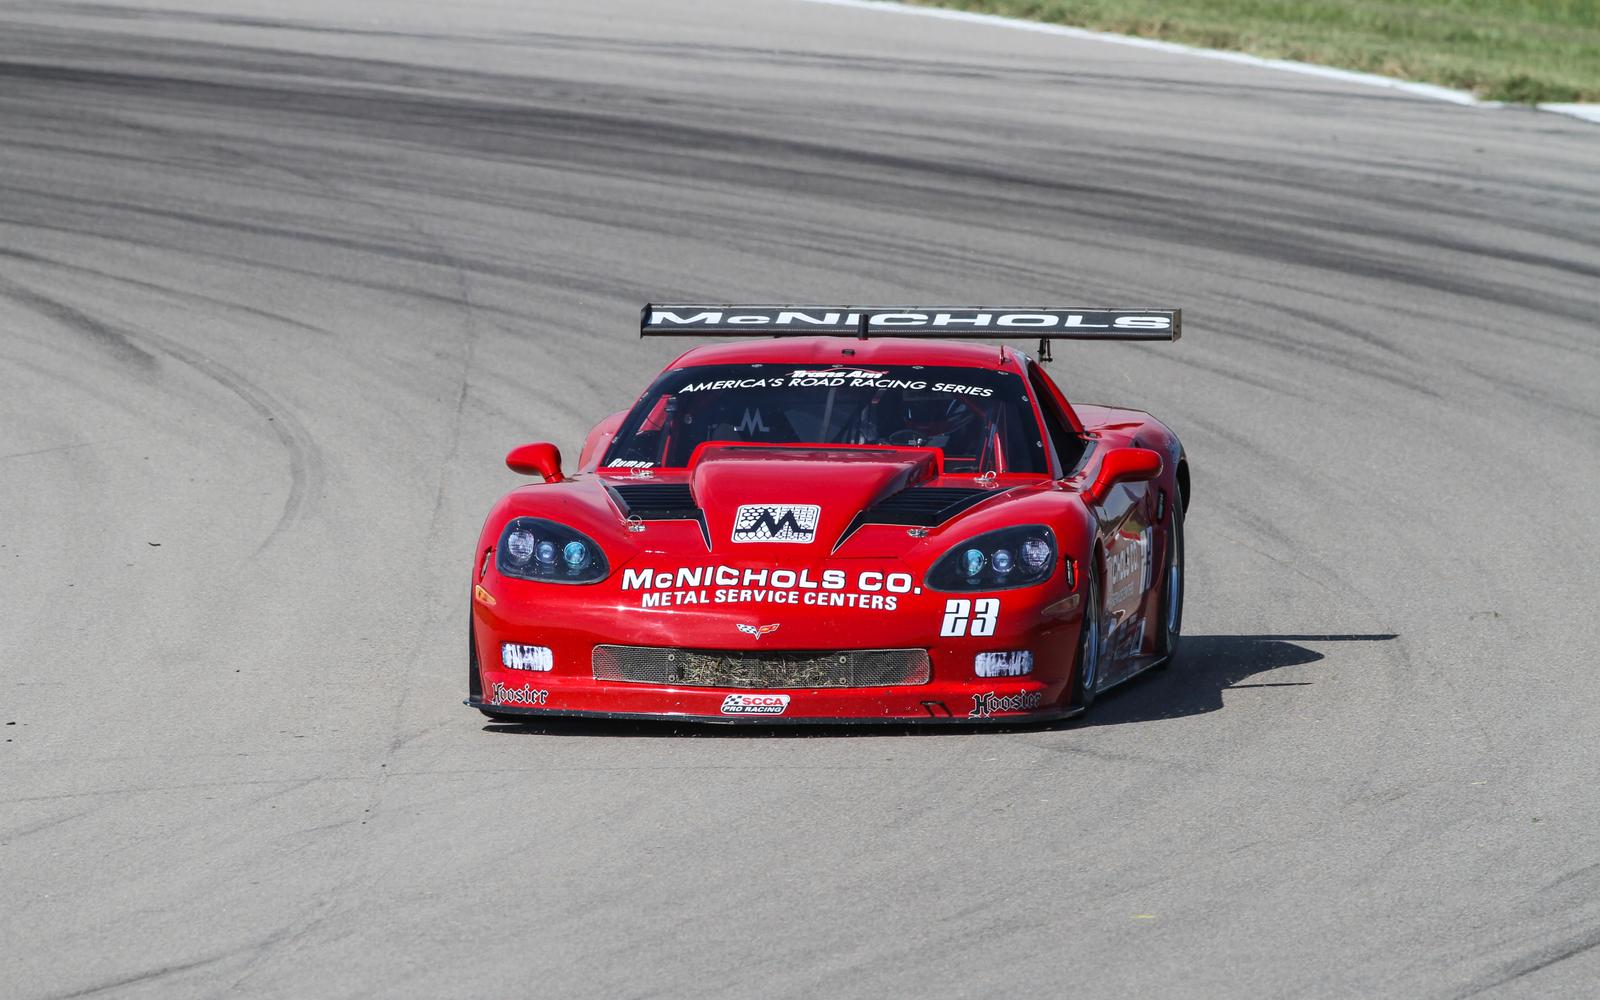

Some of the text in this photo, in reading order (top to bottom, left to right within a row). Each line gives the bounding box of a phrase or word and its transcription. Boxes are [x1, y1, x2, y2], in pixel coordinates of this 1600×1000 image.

[678, 378, 994, 397] AMERICA'S ROAD RACING SERIES
[621, 565, 923, 595] McNICHOLS CO.
[641, 589, 898, 611] METAL SERVICE CENTERS
[939, 598, 1001, 637] 23
[491, 681, 549, 706] Hoosier
[742, 697, 784, 706] SCCA
[968, 688, 1042, 718] Hoosier
[744, 705, 782, 713] RACING
